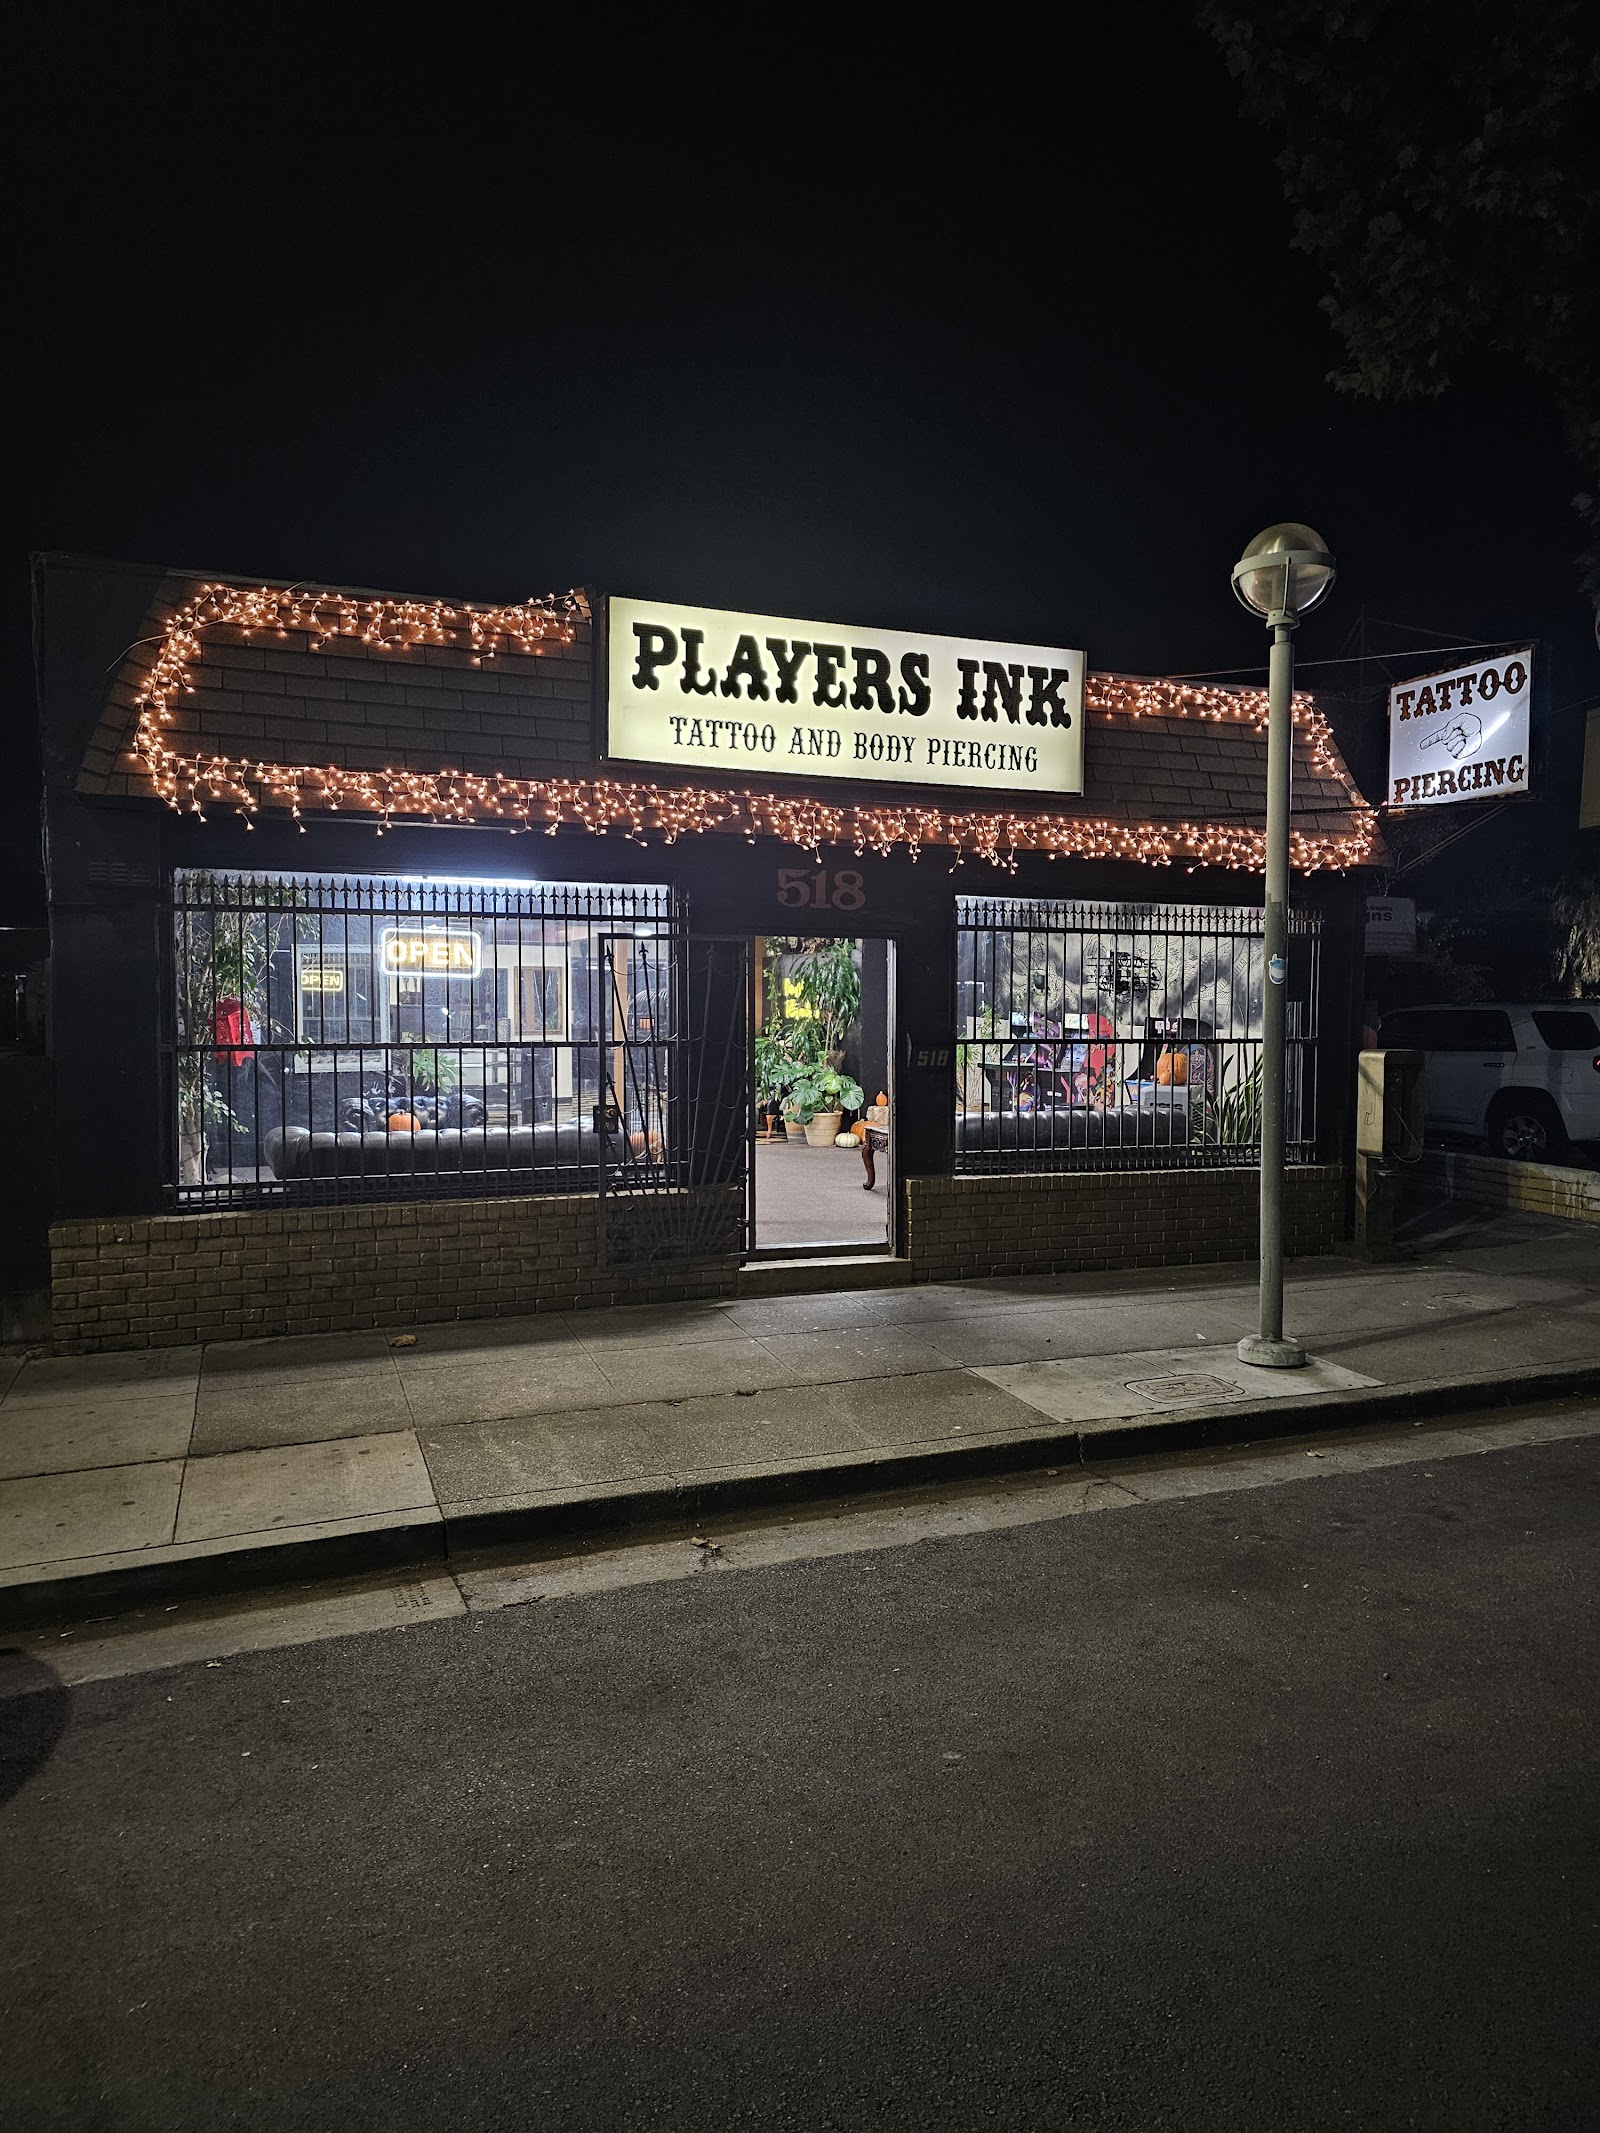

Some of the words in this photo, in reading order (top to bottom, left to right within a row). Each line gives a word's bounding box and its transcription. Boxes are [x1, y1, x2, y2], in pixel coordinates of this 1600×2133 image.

[632, 622, 931, 715] PLAYERS
[957, 659, 1072, 729] INK
[1396, 661, 1527, 721] TATTOO
[669, 716, 776, 752] TATTOO
[788, 727, 842, 757] AND
[853, 731, 917, 761] BODY
[926, 738, 1038, 772] PIERCING
[1394, 755, 1524, 804] PIERCING
[776, 868, 866, 910] 518
[387, 940, 473, 966] OPEN
[300, 974, 341, 986] OPEN
[916, 1050, 950, 1067] 518
